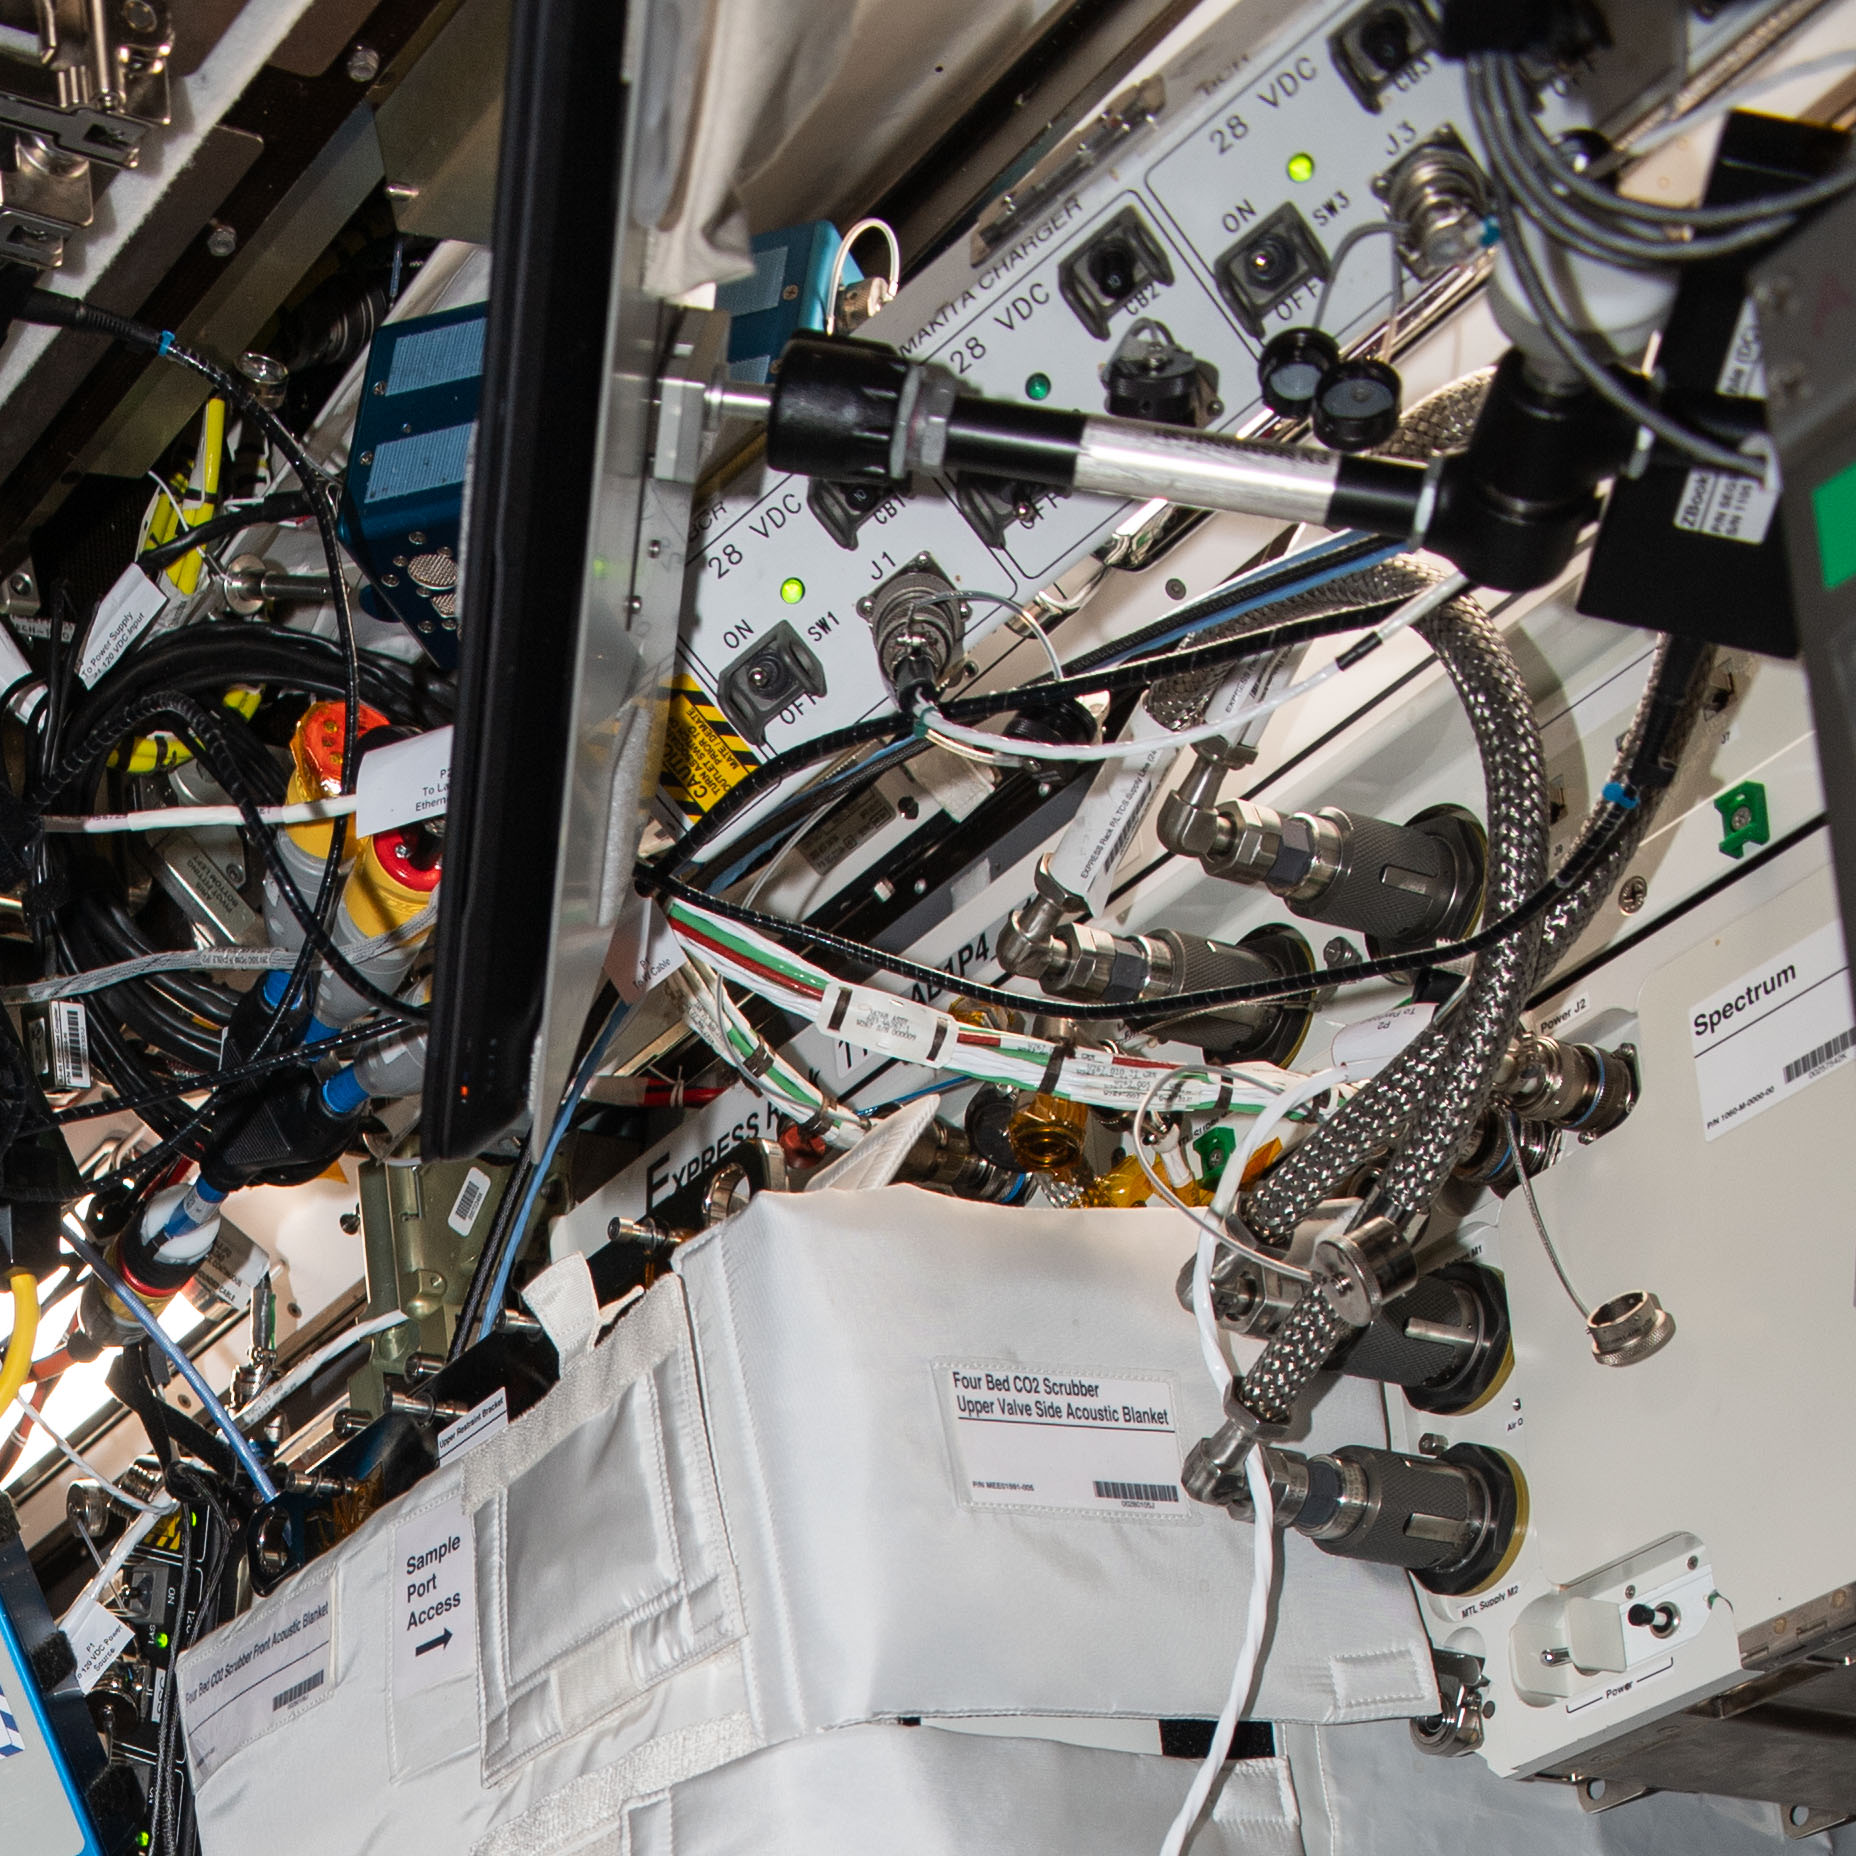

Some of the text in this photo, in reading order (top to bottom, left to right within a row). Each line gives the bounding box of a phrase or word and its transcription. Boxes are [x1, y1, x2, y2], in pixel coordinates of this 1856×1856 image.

[1207, 55, 1318, 155] 28 VDC
[1380, 121, 1417, 157] J3
[1220, 198, 1257, 235] ON
[894, 195, 1084, 360] MAKITA CHARGER
[947, 280, 1052, 374] 28 VDC
[1681, 474, 1709, 527] ZBook
[706, 490, 804, 578] 28 VDC
[865, 550, 896, 581] J1
[80, 610, 134, 678] To Power Supply
[101, 610, 146, 667] 120 VDC Input
[719, 618, 754, 651] ON
[805, 610, 840, 643] SW1
[686, 725, 723, 765] PRIOR TO
[1540, 998, 1587, 1032] Power J2
[1693, 963, 1796, 1038] Spectrum
[639, 1103, 759, 1212] EXPRESS
[951, 1371, 1099, 1397] Four Bed CO2 Scrubber
[955, 1394, 1169, 1425] Upper Valve Side Acoustic Blanket
[404, 1533, 462, 1577] Sample
[404, 1573, 438, 1602] Port
[1460, 1584, 1519, 1619] MTL Supply M2
[404, 1591, 461, 1630] Access
[1605, 1680, 1634, 1698] Power
